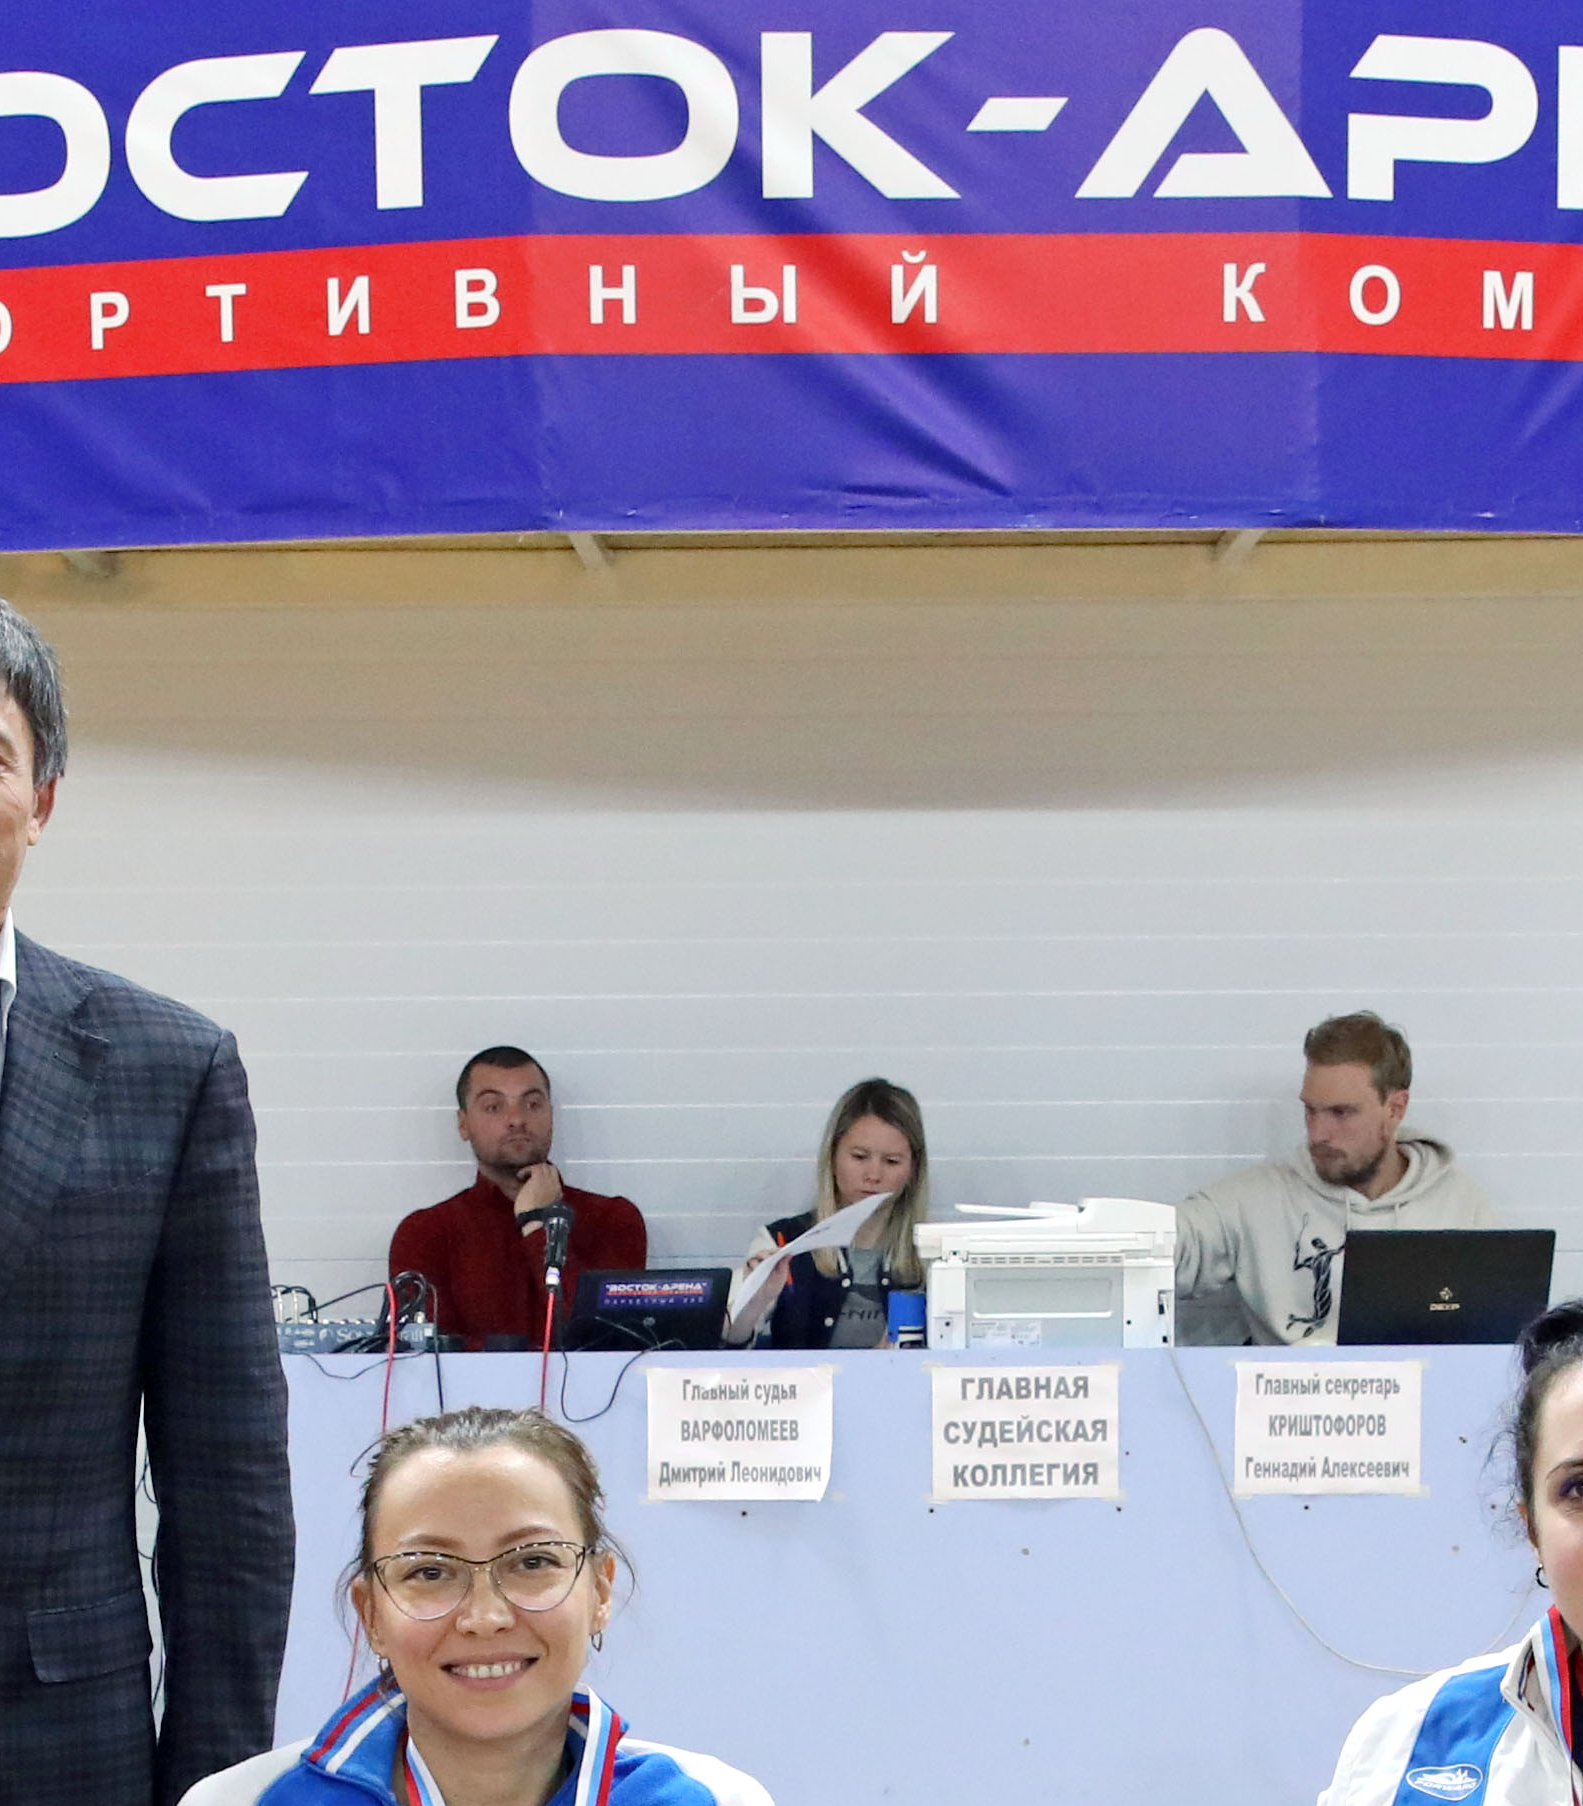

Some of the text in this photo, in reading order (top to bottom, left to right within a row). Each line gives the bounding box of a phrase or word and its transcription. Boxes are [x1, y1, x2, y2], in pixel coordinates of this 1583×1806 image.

[682, 1378, 797, 1406] Главный судья
[961, 1377, 1089, 1401] ГЛАВНАЯ
[1255, 1374, 1400, 1400] Главный секретарь
[681, 1419, 799, 1442] ВАРФОЛОМЕЕВ
[944, 1416, 1108, 1448] СУДЕЙСКАЯ
[1269, 1413, 1387, 1439] КРИШТОФОРОВ
[659, 1462, 821, 1488] Дмитрий Леонидович
[953, 1463, 1099, 1488] КОЛЛЕГИЯ
[1245, 1456, 1410, 1480] Геннадий Алексеевич
